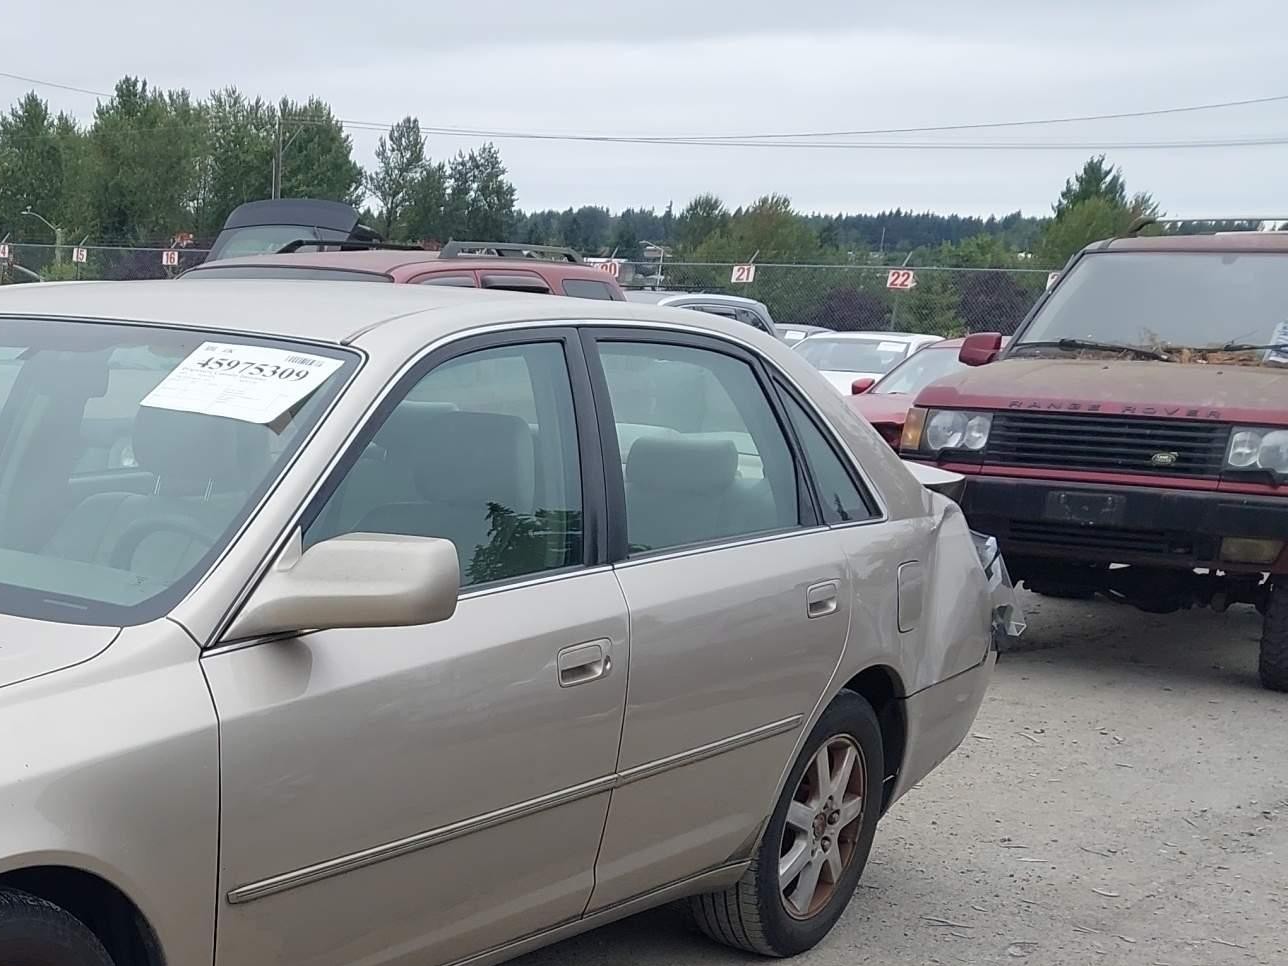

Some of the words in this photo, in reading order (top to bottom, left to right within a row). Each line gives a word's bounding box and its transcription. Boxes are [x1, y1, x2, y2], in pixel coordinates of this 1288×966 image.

[75, 249, 85, 262] 15
[166, 252, 176, 264] 16
[735, 266, 752, 282] 21
[888, 271, 911, 287] 22
[196, 356, 310, 382] 45975309
[1008, 400, 1101, 412] RANGE
[1120, 406, 1222, 419] ROVER
